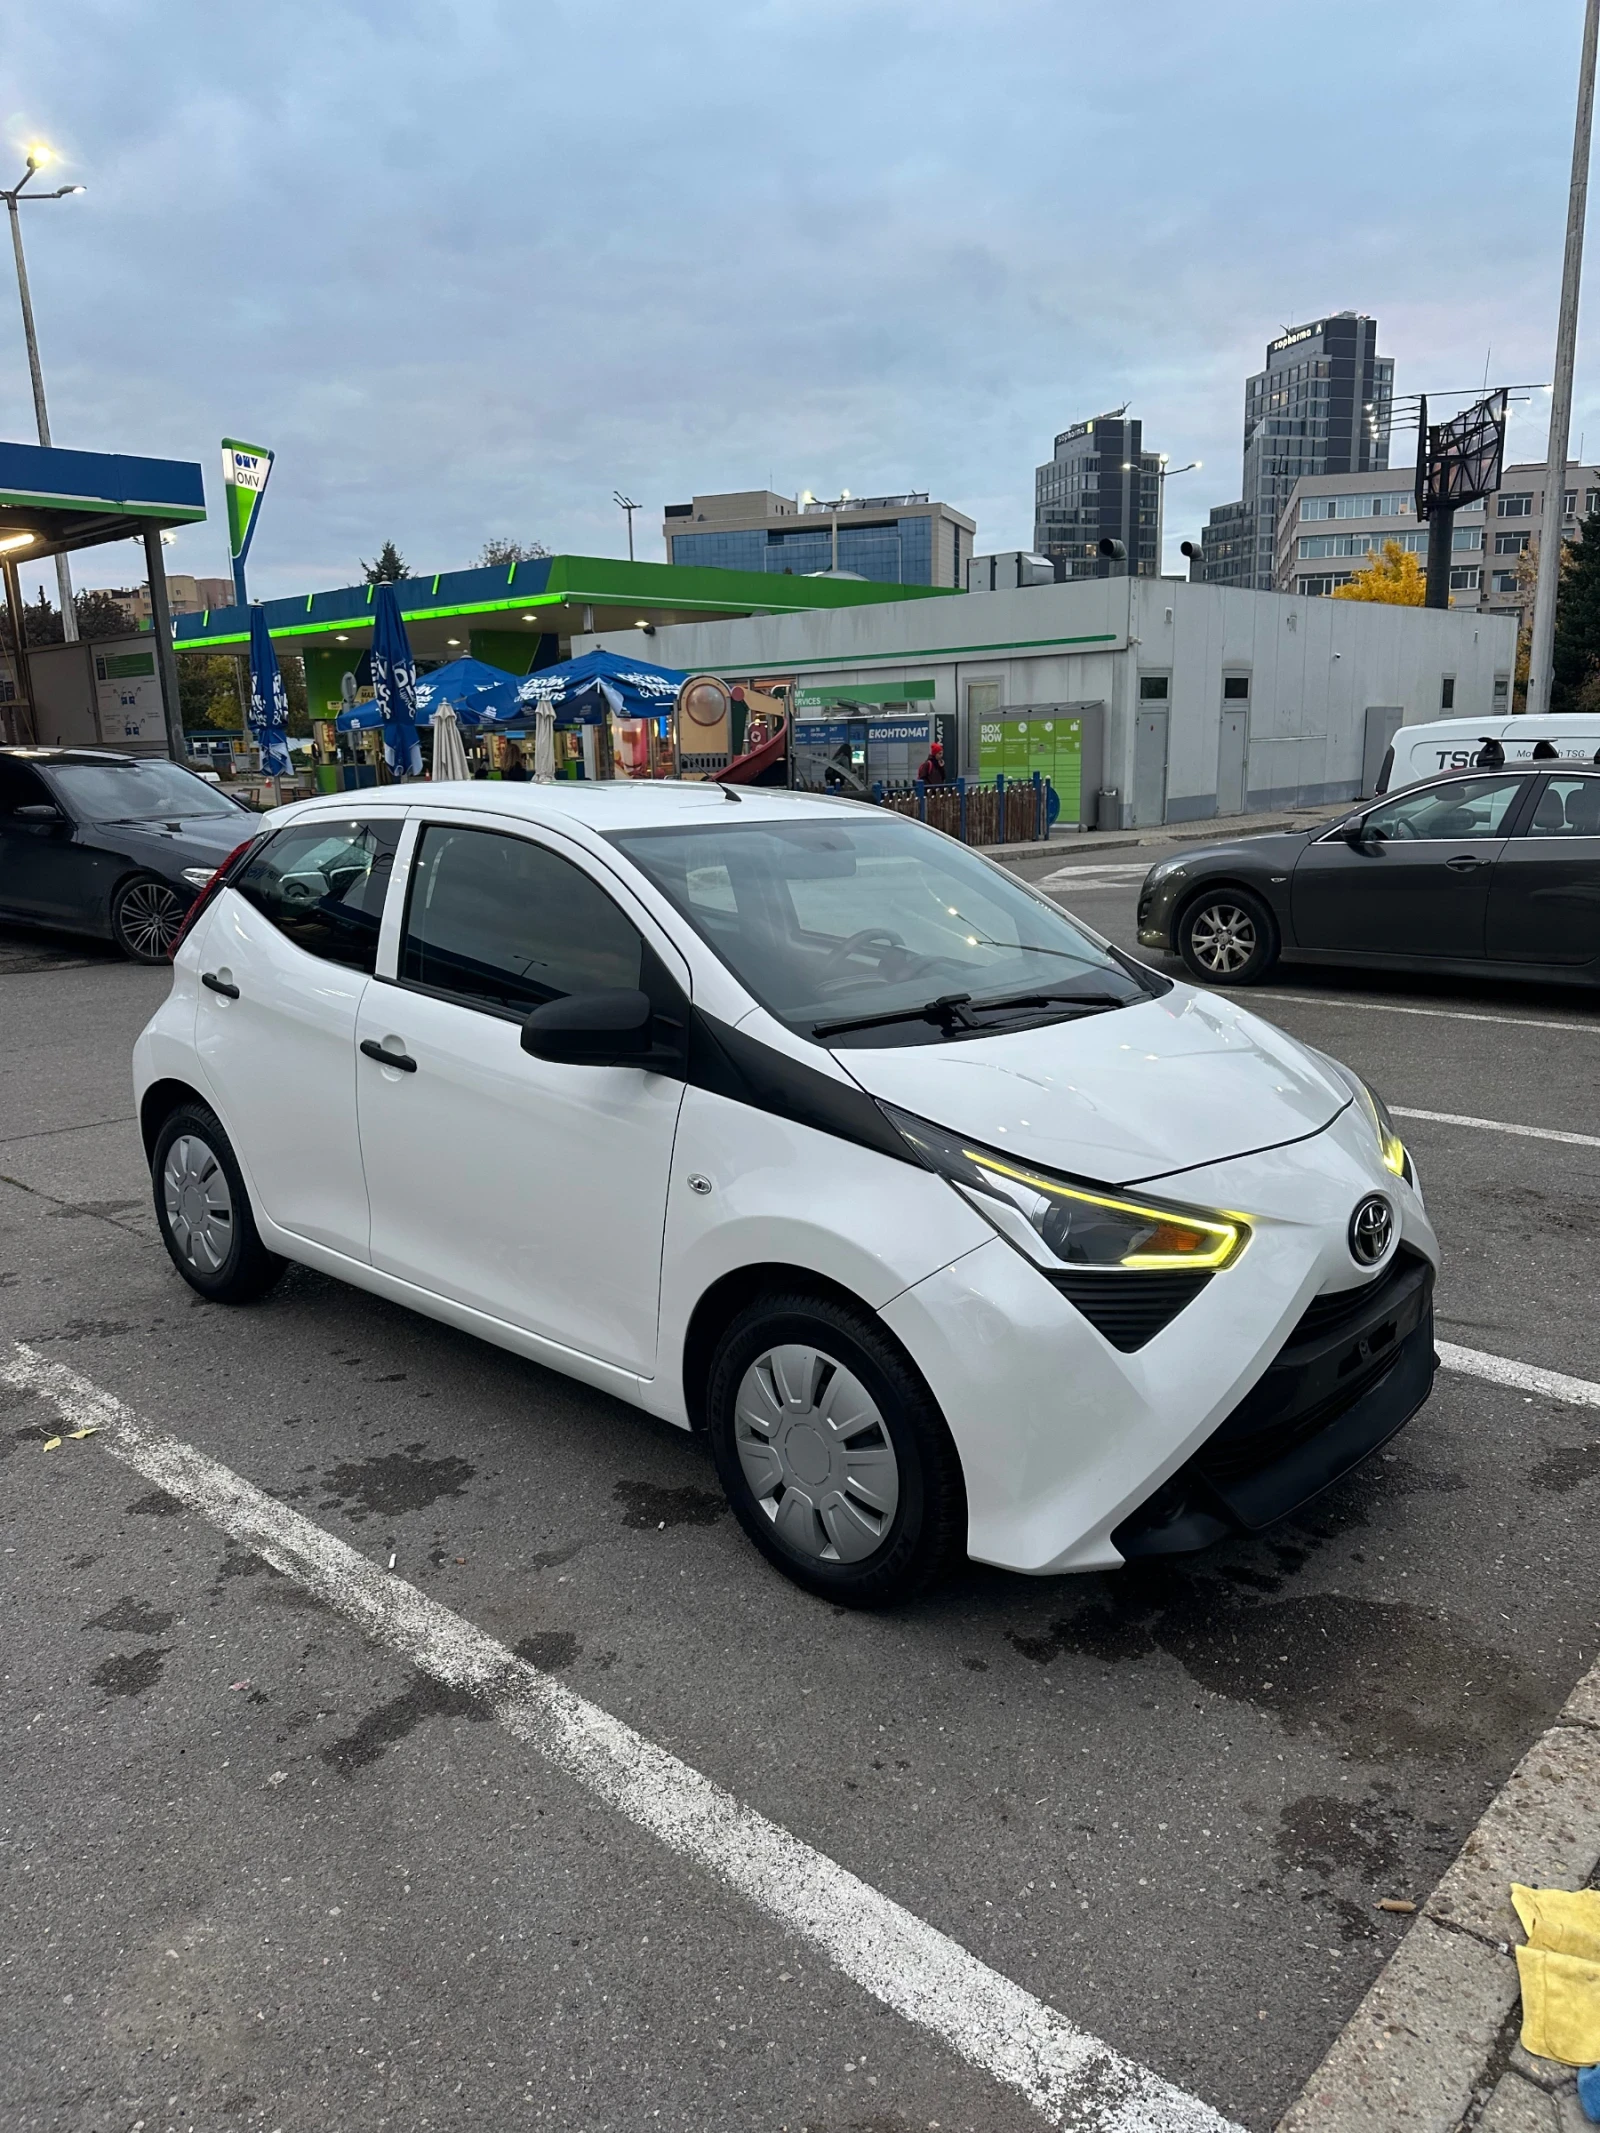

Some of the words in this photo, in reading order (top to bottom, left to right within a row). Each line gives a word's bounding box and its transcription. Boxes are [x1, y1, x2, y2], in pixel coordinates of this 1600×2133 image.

[1274, 329, 1311, 350] sopharma
[1058, 427, 1085, 443] sopharma
[235, 453, 258, 469] OMV
[237, 472, 260, 487] OMV
[795, 697, 821, 706] ERVICES
[868, 727, 928, 739] ЕКОНТОМАТ
[981, 724, 1000, 733] BOX
[981, 733, 1002, 743] NOW
